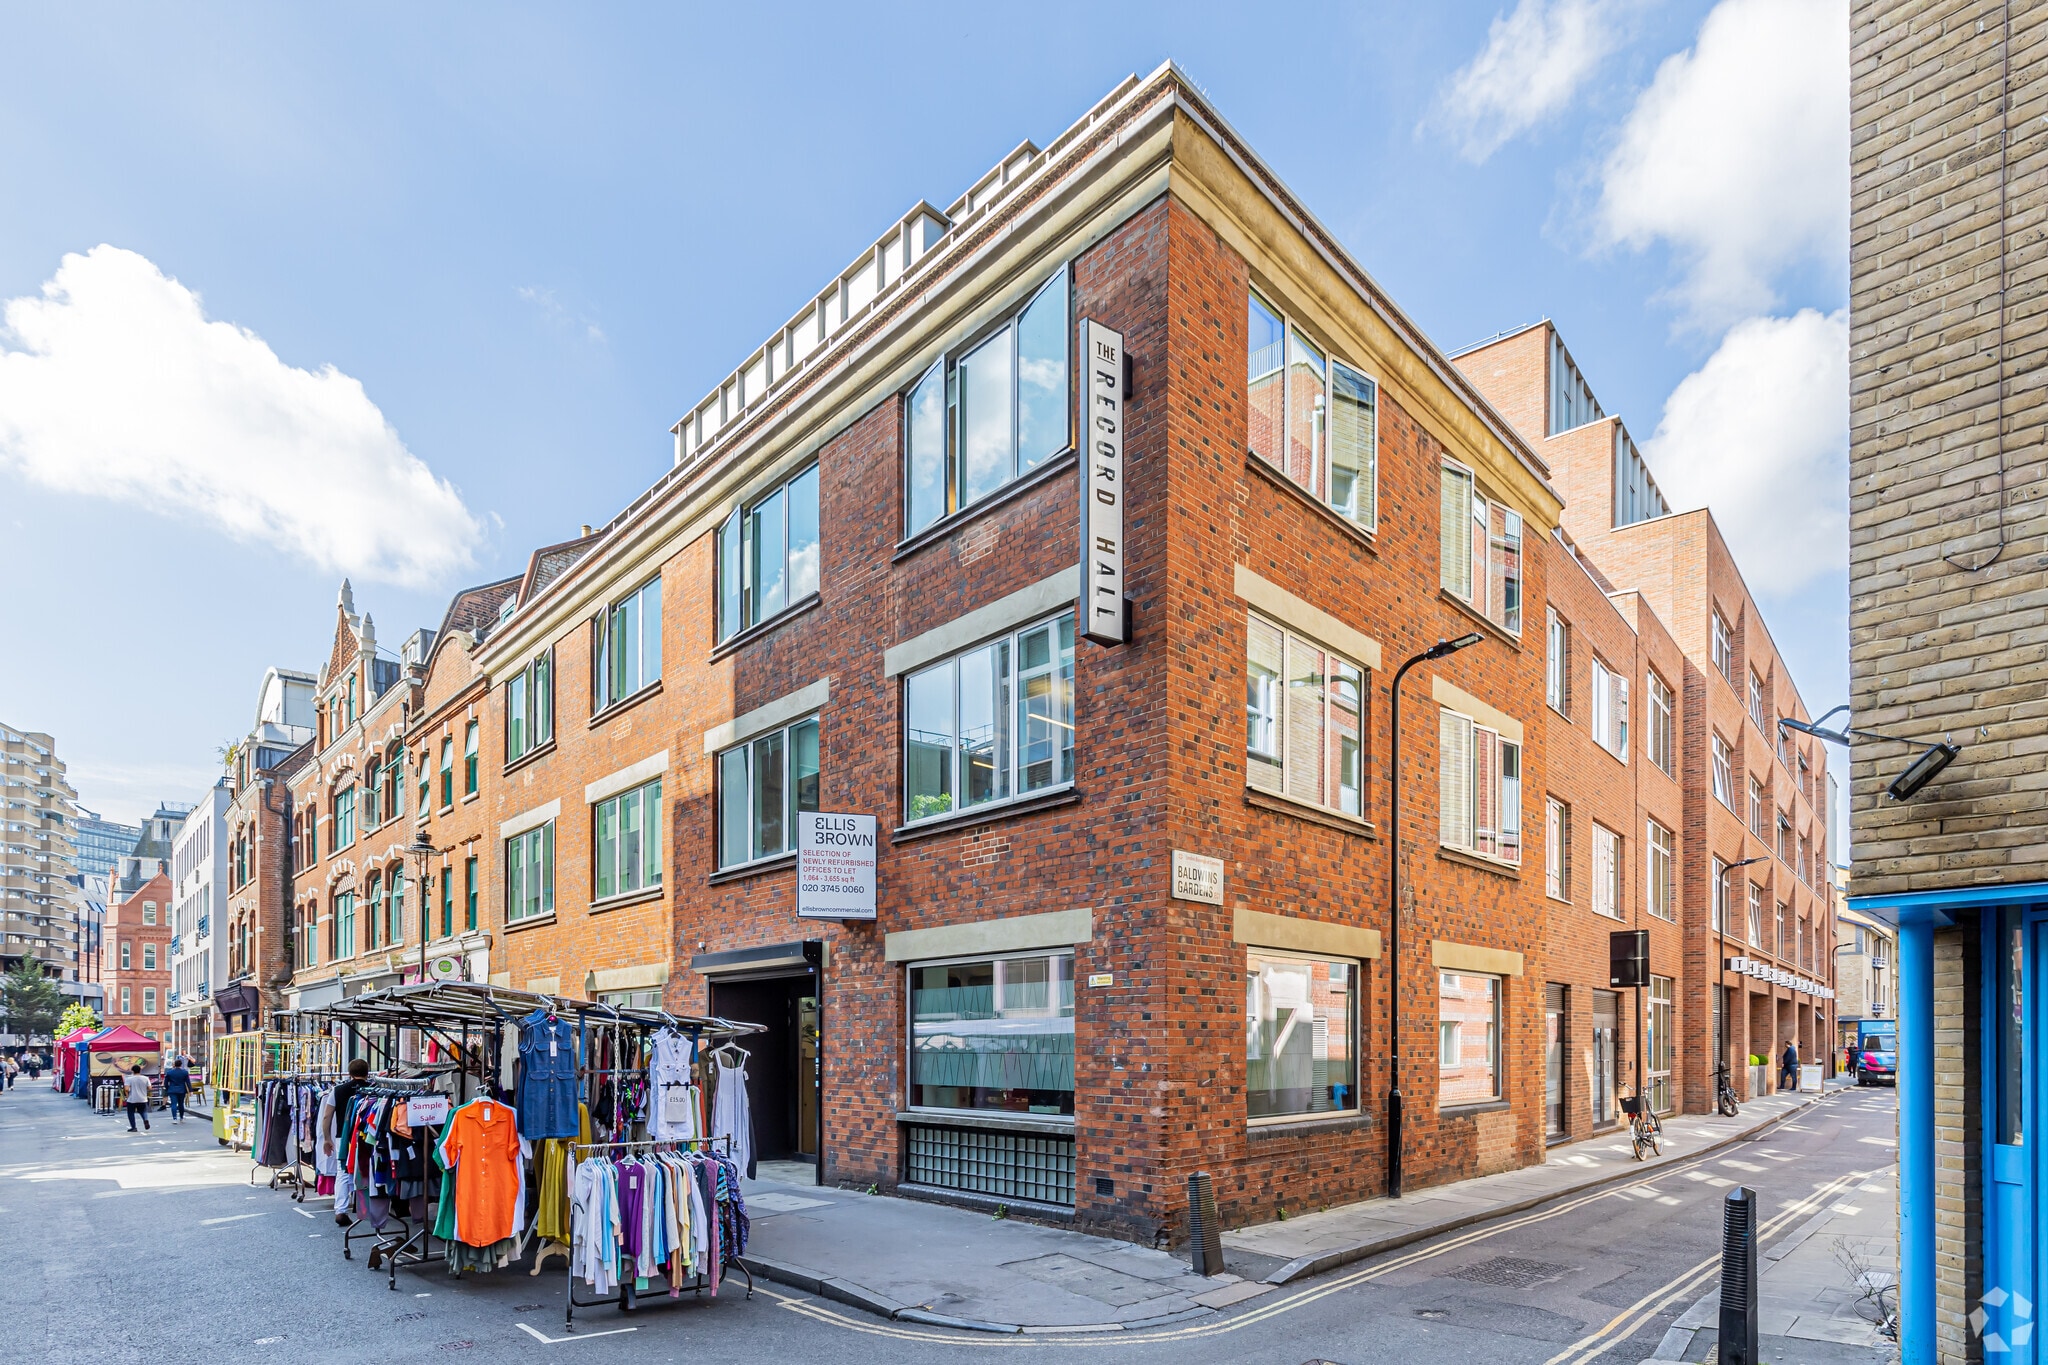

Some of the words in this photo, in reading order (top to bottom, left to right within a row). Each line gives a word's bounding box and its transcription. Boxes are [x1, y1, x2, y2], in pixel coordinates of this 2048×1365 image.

[1097, 341, 1116, 362] THE
[1096, 369, 1116, 506] RECORD
[1096, 536, 1116, 618] HALL
[815, 817, 856, 831] ELLIS
[815, 832, 873, 847] BROWN
[803, 866, 832, 874] OFFICES
[828, 859, 874, 867] REFURBISHED
[1177, 866, 1218, 885] BALDWINS
[802, 884, 819, 892] 020
[820, 884, 841, 893] 3745
[842, 885, 865, 894] 0060
[1177, 881, 1213, 898] GARDENS
[802, 906, 874, 914] ellisbrowncommercial.com
[412, 1101, 443, 1110] Sample
